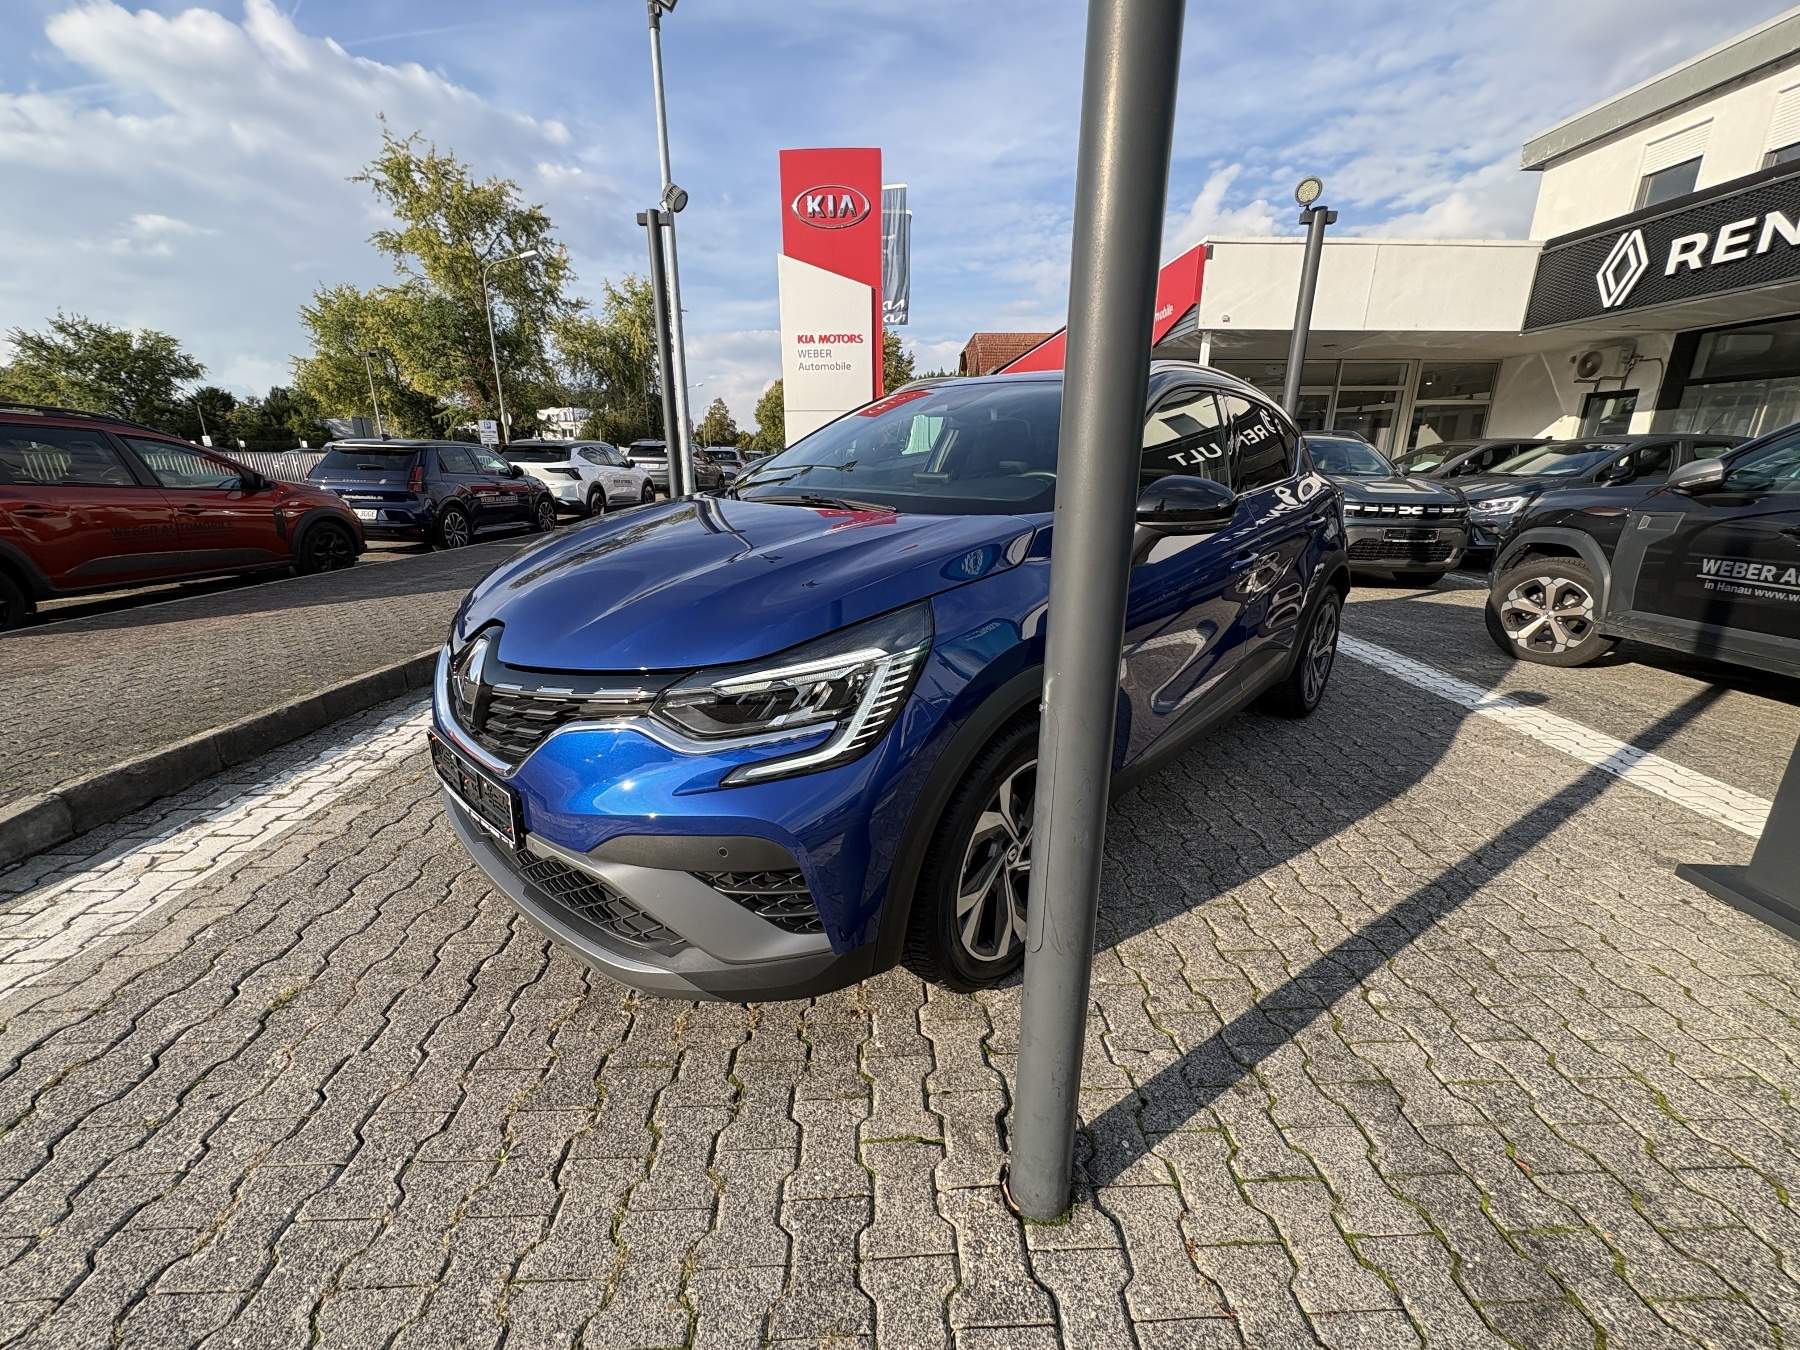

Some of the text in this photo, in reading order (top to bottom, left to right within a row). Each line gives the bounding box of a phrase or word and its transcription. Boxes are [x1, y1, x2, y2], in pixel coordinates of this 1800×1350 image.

[806, 194, 857, 218] KIA
[1664, 210, 1800, 277] REN
[797, 333, 864, 344] KIA MOTORS
[797, 349, 832, 358] WEBER
[799, 361, 852, 371] Automobile
[1702, 558, 1800, 585] WEBER A
[1704, 580, 1800, 602] in Hanau www.w
